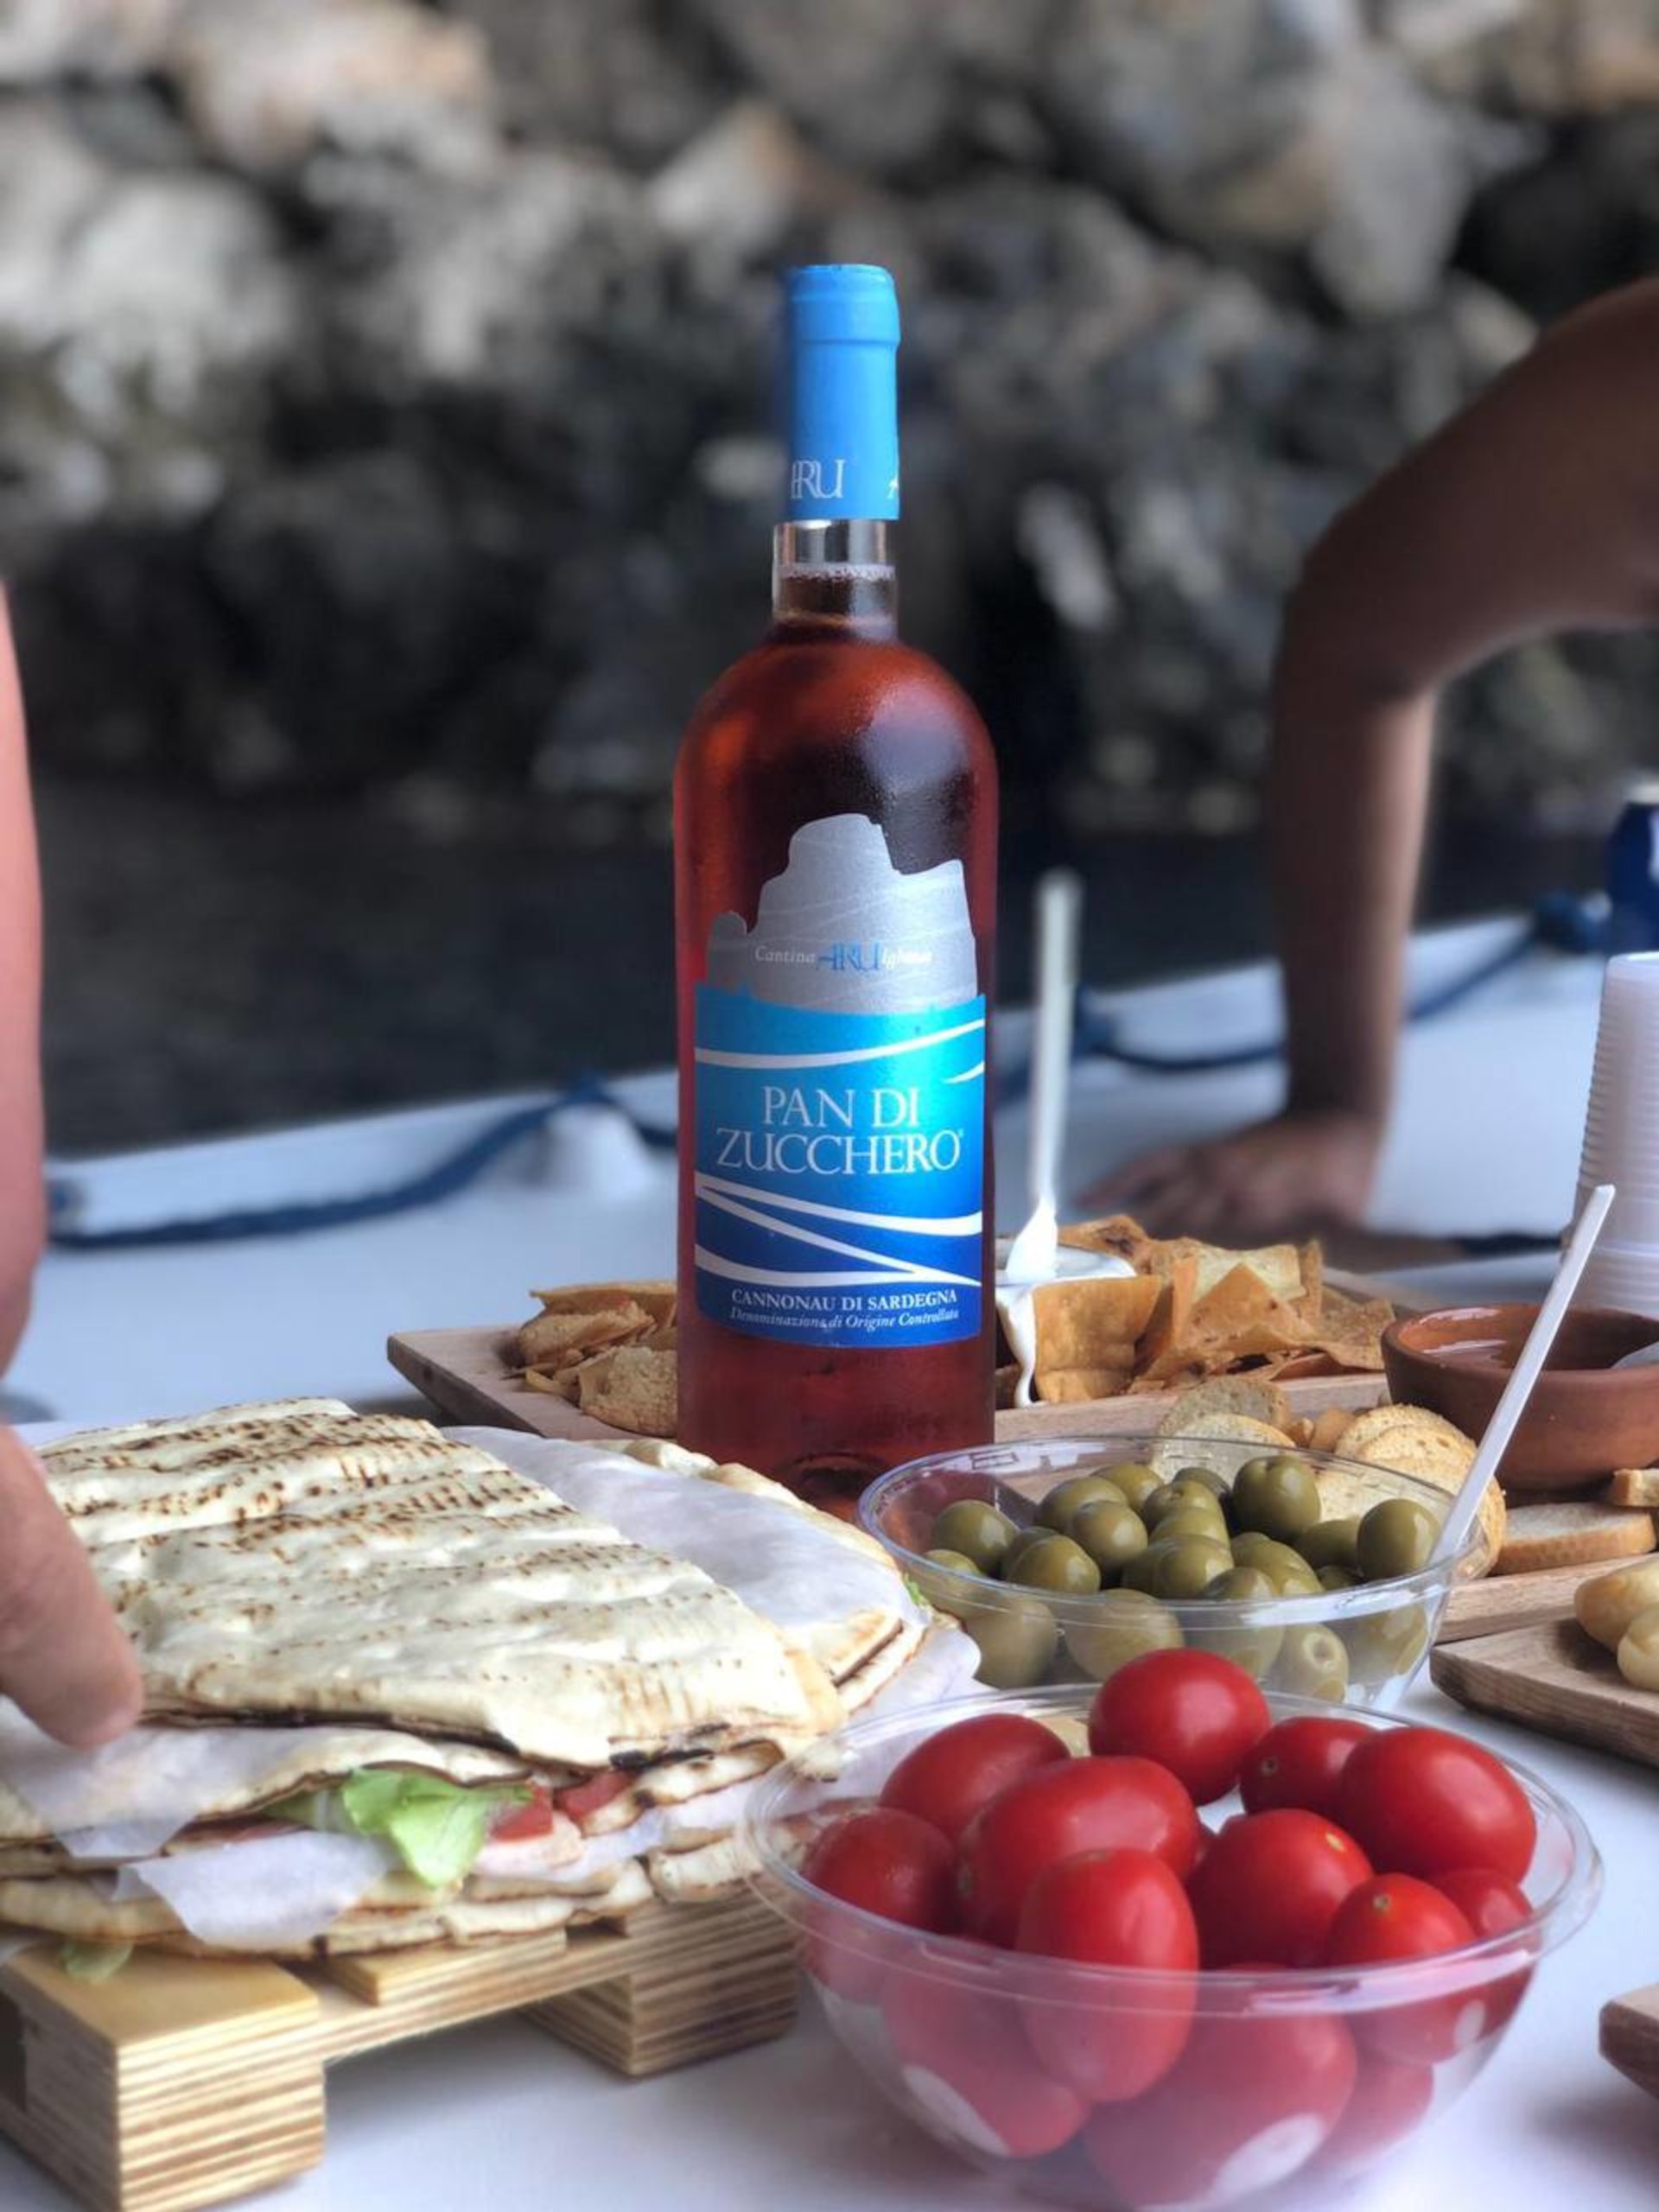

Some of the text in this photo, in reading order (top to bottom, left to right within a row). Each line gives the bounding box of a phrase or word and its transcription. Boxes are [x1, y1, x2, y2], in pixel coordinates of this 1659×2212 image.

[754, 945, 816, 964] Cantina
[762, 1085, 921, 1128] PAN DI
[715, 1128, 963, 1176] ZUCCHERO
[731, 1288, 957, 1312] CANNONAU DI SARDEGNA
[845, 1313, 896, 1332] Origine
